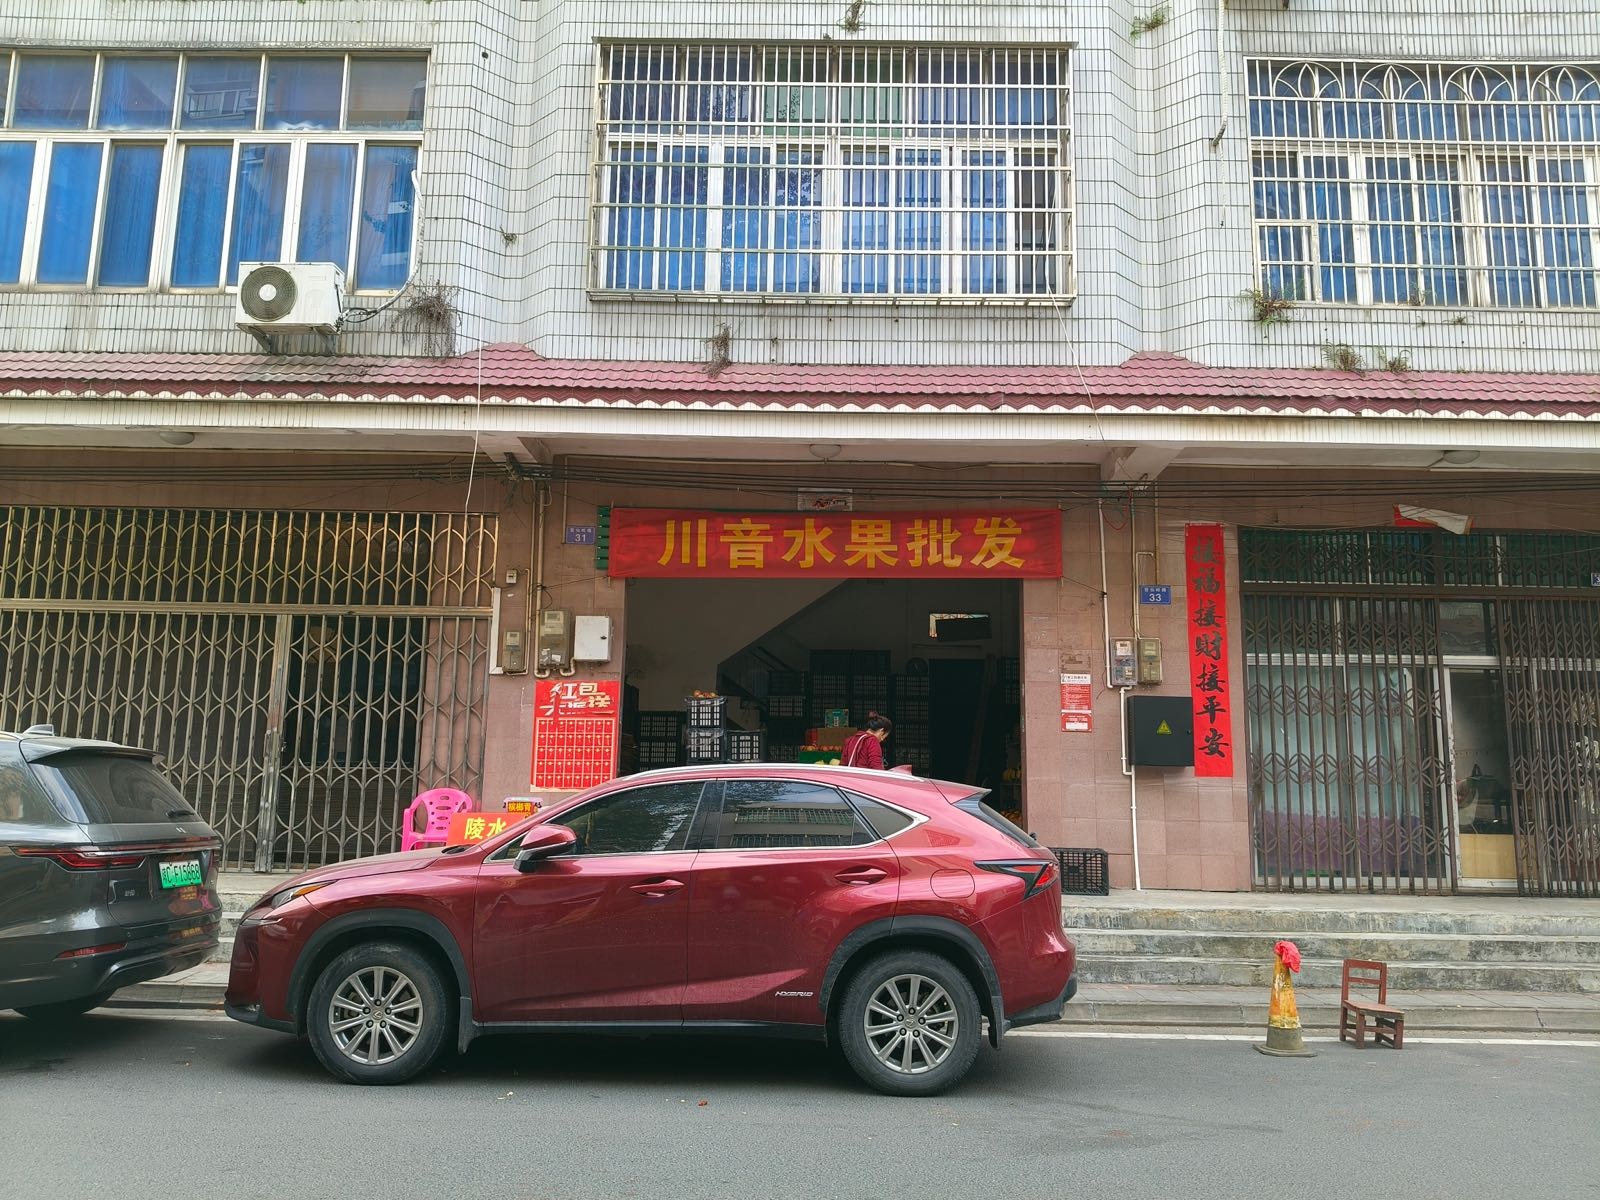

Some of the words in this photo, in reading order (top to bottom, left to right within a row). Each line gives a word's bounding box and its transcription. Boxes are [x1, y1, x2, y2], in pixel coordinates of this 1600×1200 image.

[575, 533, 586, 543] 31
[657, 517, 1025, 569] 川音水果批发
[1149, 593, 1162, 602] 33
[550, 682, 606, 700] 红包
[464, 816, 507, 840] 陵水
[774, 990, 814, 998] HYBRID
